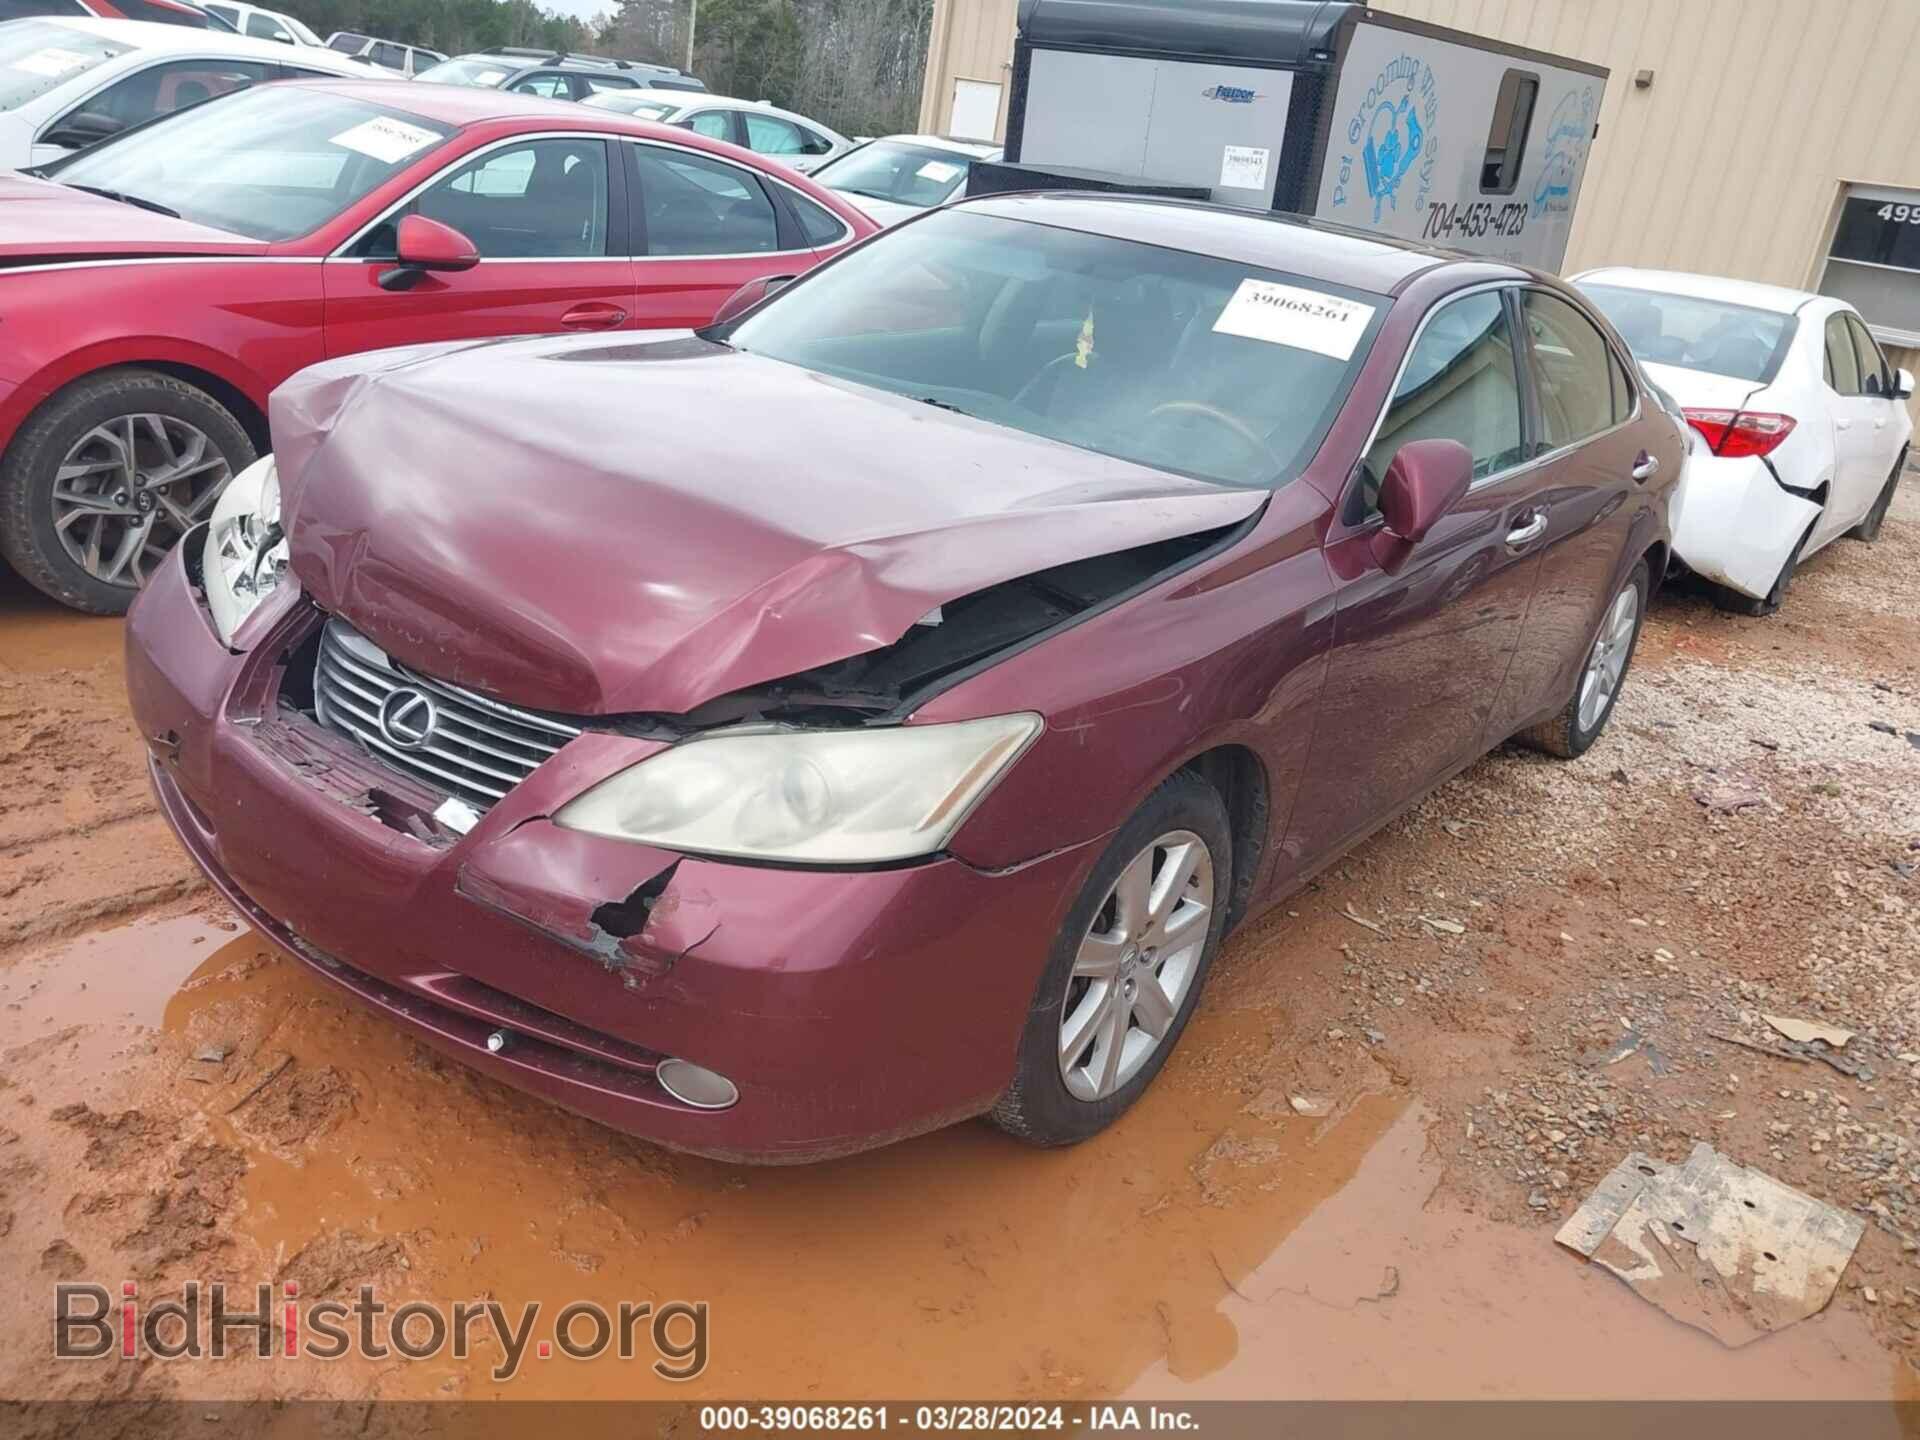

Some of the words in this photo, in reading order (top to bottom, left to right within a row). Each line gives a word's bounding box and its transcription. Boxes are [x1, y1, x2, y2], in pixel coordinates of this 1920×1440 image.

[1215, 85, 1256, 99] FREEDOM
[1333, 154, 1353, 207] Pet
[1349, 53, 1420, 145] Grooming
[1415, 135, 1438, 213] Style
[1422, 202, 1528, 239] 704-453-4723
[1251, 291, 1349, 322] 39068261
